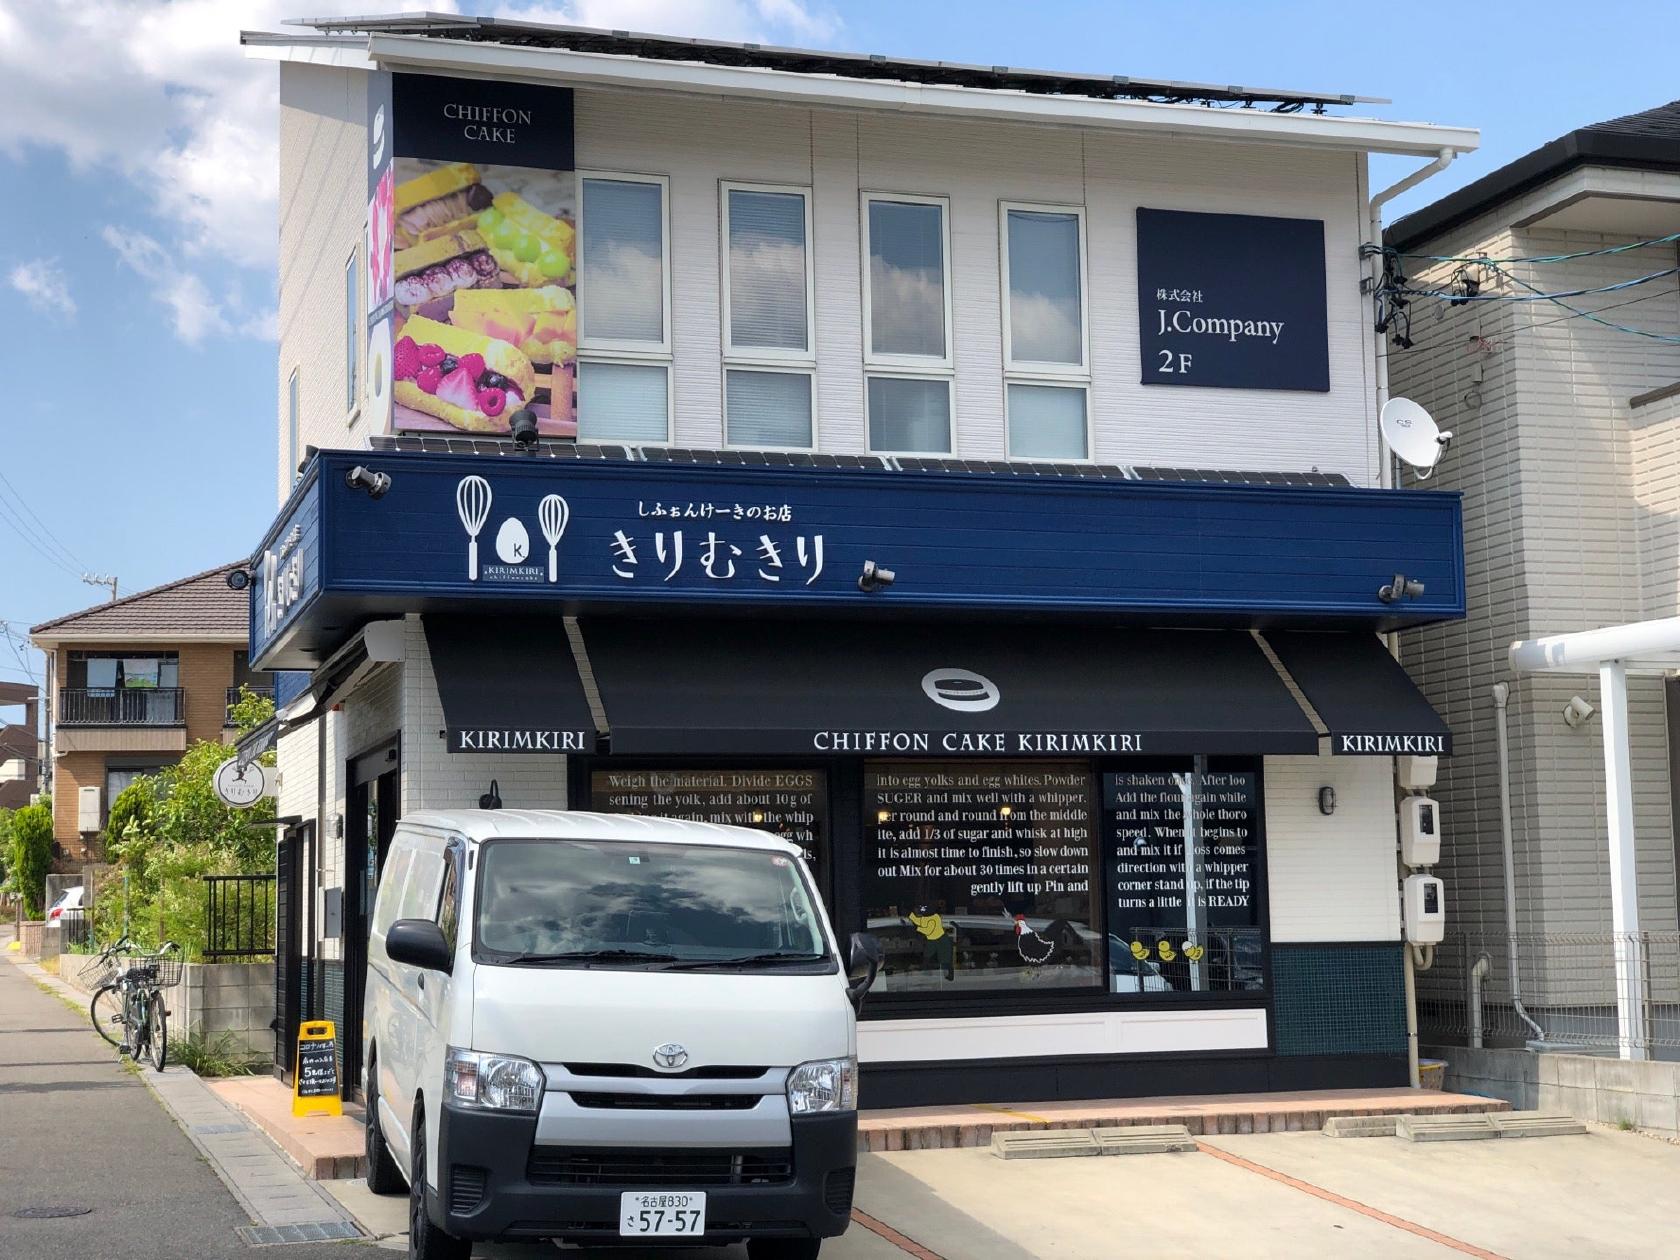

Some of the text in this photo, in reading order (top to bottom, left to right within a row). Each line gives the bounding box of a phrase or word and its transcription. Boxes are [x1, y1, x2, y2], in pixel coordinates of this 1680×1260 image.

[444, 103, 532, 125] CHIFFON
[464, 125, 516, 144] CAKE
[1156, 288, 1203, 303] 株式会社
[1158, 309, 1285, 344] J.Company
[1158, 350, 1193, 373] 2F
[639, 501, 792, 522] しふぉんけーきのお店
[609, 530, 823, 585] きりむきり
[488, 566, 539, 576] KIRIMKIRI
[459, 730, 585, 750] KIRIMKIRI
[813, 732, 1143, 752] CHIFFON CAKE KIRIMKIRI
[1341, 735, 1445, 752] KIRIMKIRI
[609, 775, 645, 788] Weigh
[651, 776, 669, 787] the
[732, 776, 771, 787] Divide
[775, 775, 813, 787] EGGS
[902, 776, 920, 787] egg
[924, 774, 954, 788] yolks
[958, 774, 979, 785] and
[983, 776, 1001, 787] egg
[1044, 774, 1085, 785] Powder
[1115, 775, 1124, 785] is
[1127, 774, 1165, 785] shaken
[1200, 774, 1227, 785] After
[654, 794, 672, 805] the
[675, 794, 705, 808] yolk,
[710, 794, 732, 805] add
[737, 794, 770, 805] about
[800, 794, 811, 805] of
[877, 792, 922, 804] SUGER
[927, 792, 948, 803] and
[953, 792, 972, 803] mix
[977, 792, 998, 802] well
[1002, 792, 1025, 802] with
[1116, 792, 1137, 803] Add
[1140, 792, 1157, 802] the
[1160, 792, 1185, 802] flour
[1220, 792, 1247, 802] while
[710, 812, 731, 823] mix
[764, 812, 781, 823] the
[786, 812, 814, 825] whip
[900, 811, 935, 821] round
[938, 811, 959, 821] and
[962, 811, 996, 821] round
[1030, 810, 1047, 820] the
[1050, 810, 1087, 820] middle
[1116, 809, 1137, 820] and
[1140, 809, 1159, 820] mix
[1164, 809, 1181, 819] the
[1218, 809, 1247, 820] thoro
[797, 830, 813, 840] wh
[899, 828, 920, 839] add
[925, 828, 941, 839] 1/3
[943, 828, 955, 839] of
[958, 830, 989, 841] sugar
[991, 828, 1012, 839] and
[1016, 828, 1047, 838] whisk
[1051, 829, 1060, 838] at
[1064, 827, 1087, 841] high
[1154, 827, 1185, 838] When
[1200, 827, 1235, 840] begins
[1237, 827, 1247, 837] to
[878, 847, 887, 858] it
[890, 847, 899, 858] is
[901, 847, 938, 858] almost
[941, 847, 965, 857] time
[969, 848, 979, 857] to
[1020, 849, 1031, 857] so
[1034, 846, 1059, 857] slow
[1060, 846, 1088, 857] down
[1117, 844, 1138, 856] and
[1141, 845, 1160, 855] mix
[1163, 845, 1171, 855] it
[1174, 845, 1182, 855] if
[1214, 845, 1245, 855] comes
[878, 866, 896, 877] out
[900, 865, 921, 876] Mix
[925, 865, 941, 876] for
[944, 865, 977, 875] about
[980, 865, 993, 875] 30
[996, 865, 1024, 875] times
[1027, 864, 1037, 874] in
[1049, 864, 1088, 874] certain
[1118, 862, 1167, 873] direction
[1196, 864, 1201, 872] a
[1205, 862, 1248, 875] whipper
[971, 881, 1088, 896] gently lift up Pin and
[1118, 880, 1152, 890] corner
[1155, 879, 1184, 890] stand
[1206, 879, 1215, 889] if
[1216, 879, 1232, 889] the
[1235, 878, 1250, 892] tip
[1119, 897, 1146, 908] turns
[1149, 899, 1154, 907] a
[1158, 897, 1182, 907] little
[1198, 896, 1206, 907] is
[1208, 895, 1249, 907] READY
[627, 1210, 701, 1232] さ 57-57
